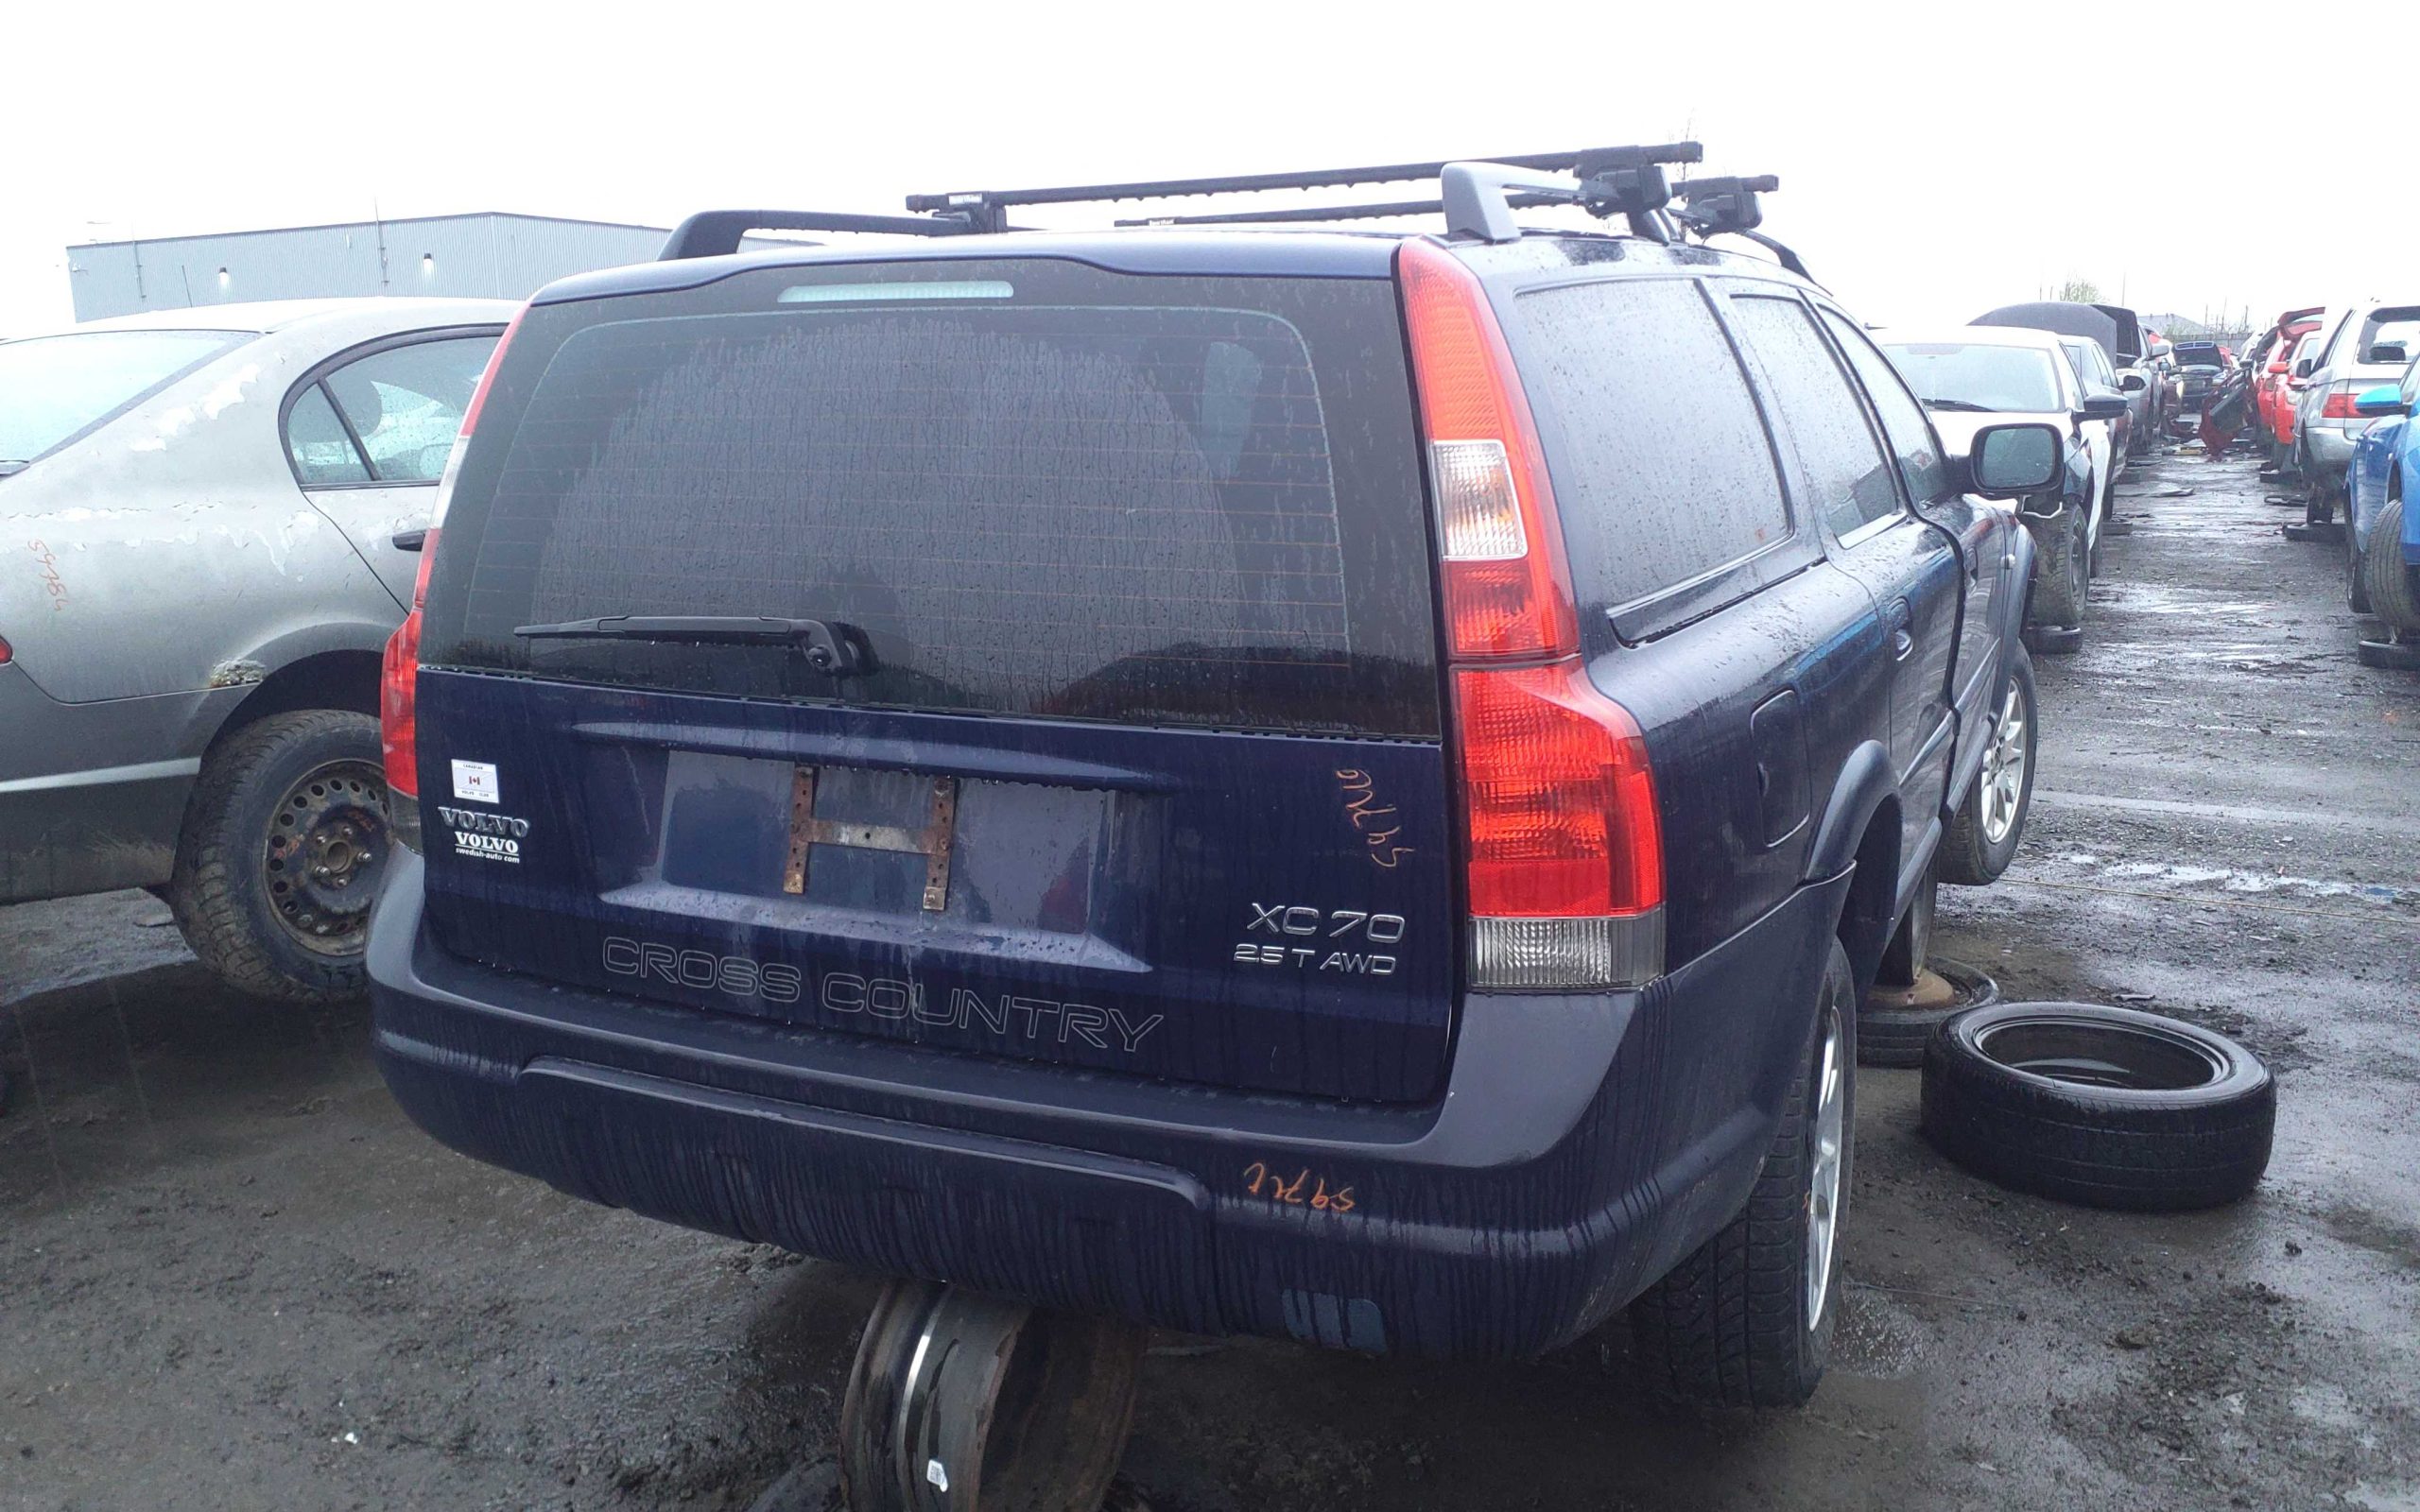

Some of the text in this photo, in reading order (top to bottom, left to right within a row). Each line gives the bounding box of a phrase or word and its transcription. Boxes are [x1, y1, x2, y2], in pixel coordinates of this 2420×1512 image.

[438, 806, 529, 838] VOLVO
[455, 831, 519, 853] VOLVO
[1319, 952, 1396, 975] AWD
[602, 936, 1165, 1053] CROSS COUNTRY
